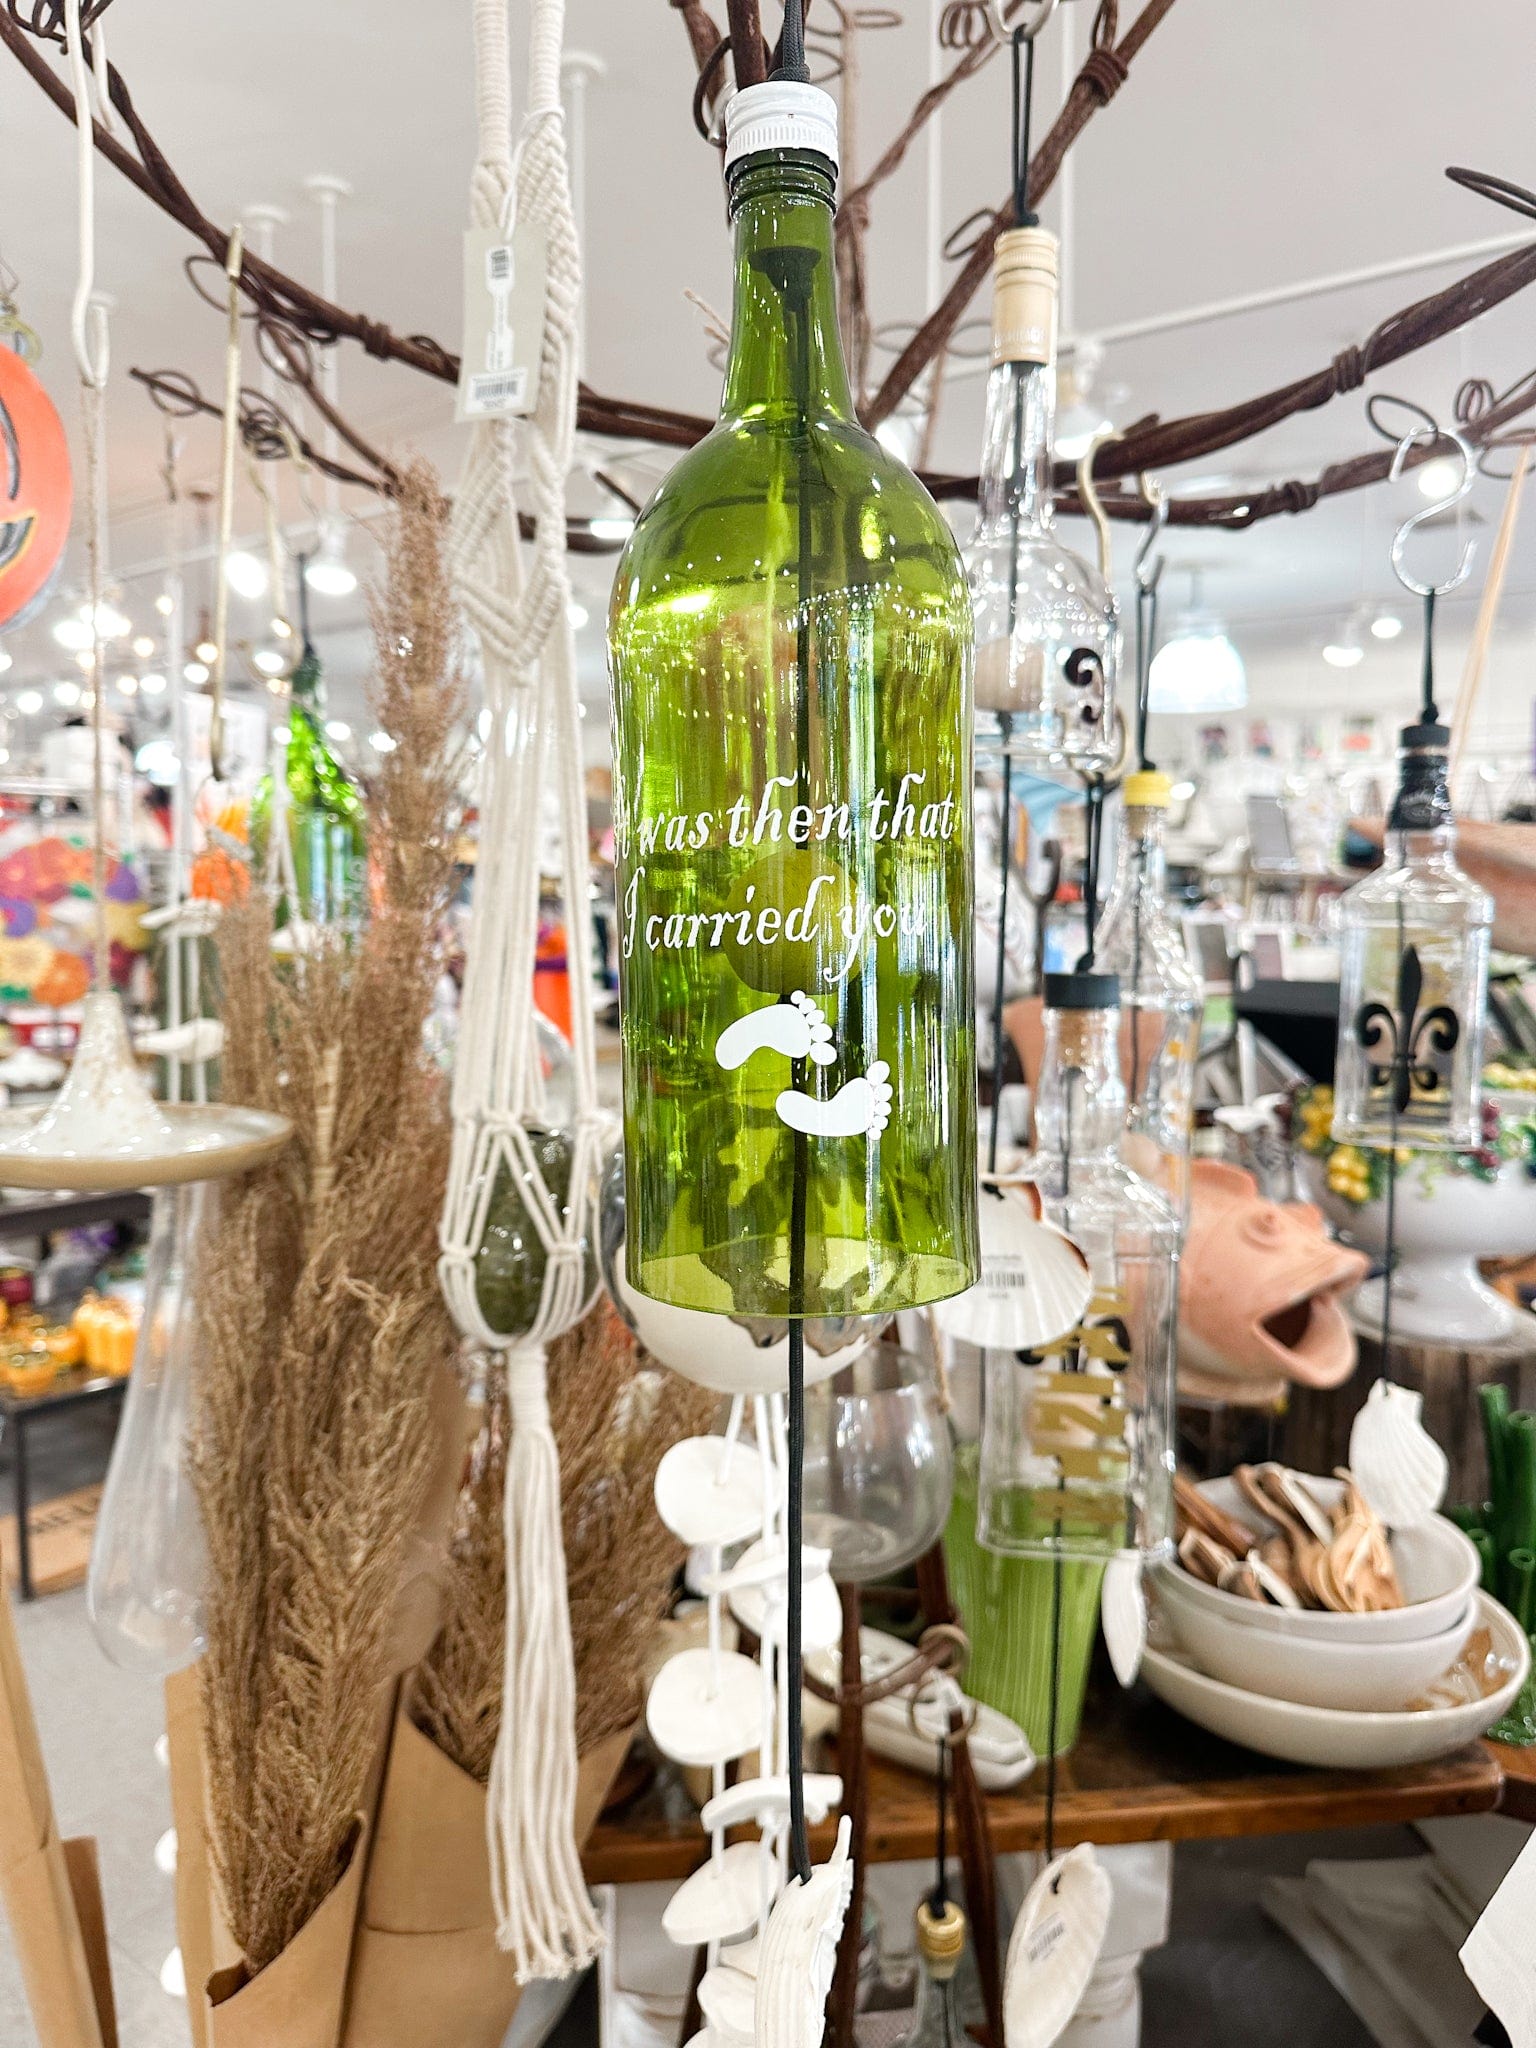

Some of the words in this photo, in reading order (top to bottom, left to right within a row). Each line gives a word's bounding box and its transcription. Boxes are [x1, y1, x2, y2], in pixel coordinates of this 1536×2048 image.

[637, 810, 714, 857] was
[727, 772, 851, 847] then
[869, 769, 955, 840] that
[645, 875, 836, 951] carried
[823, 898, 928, 983] you
